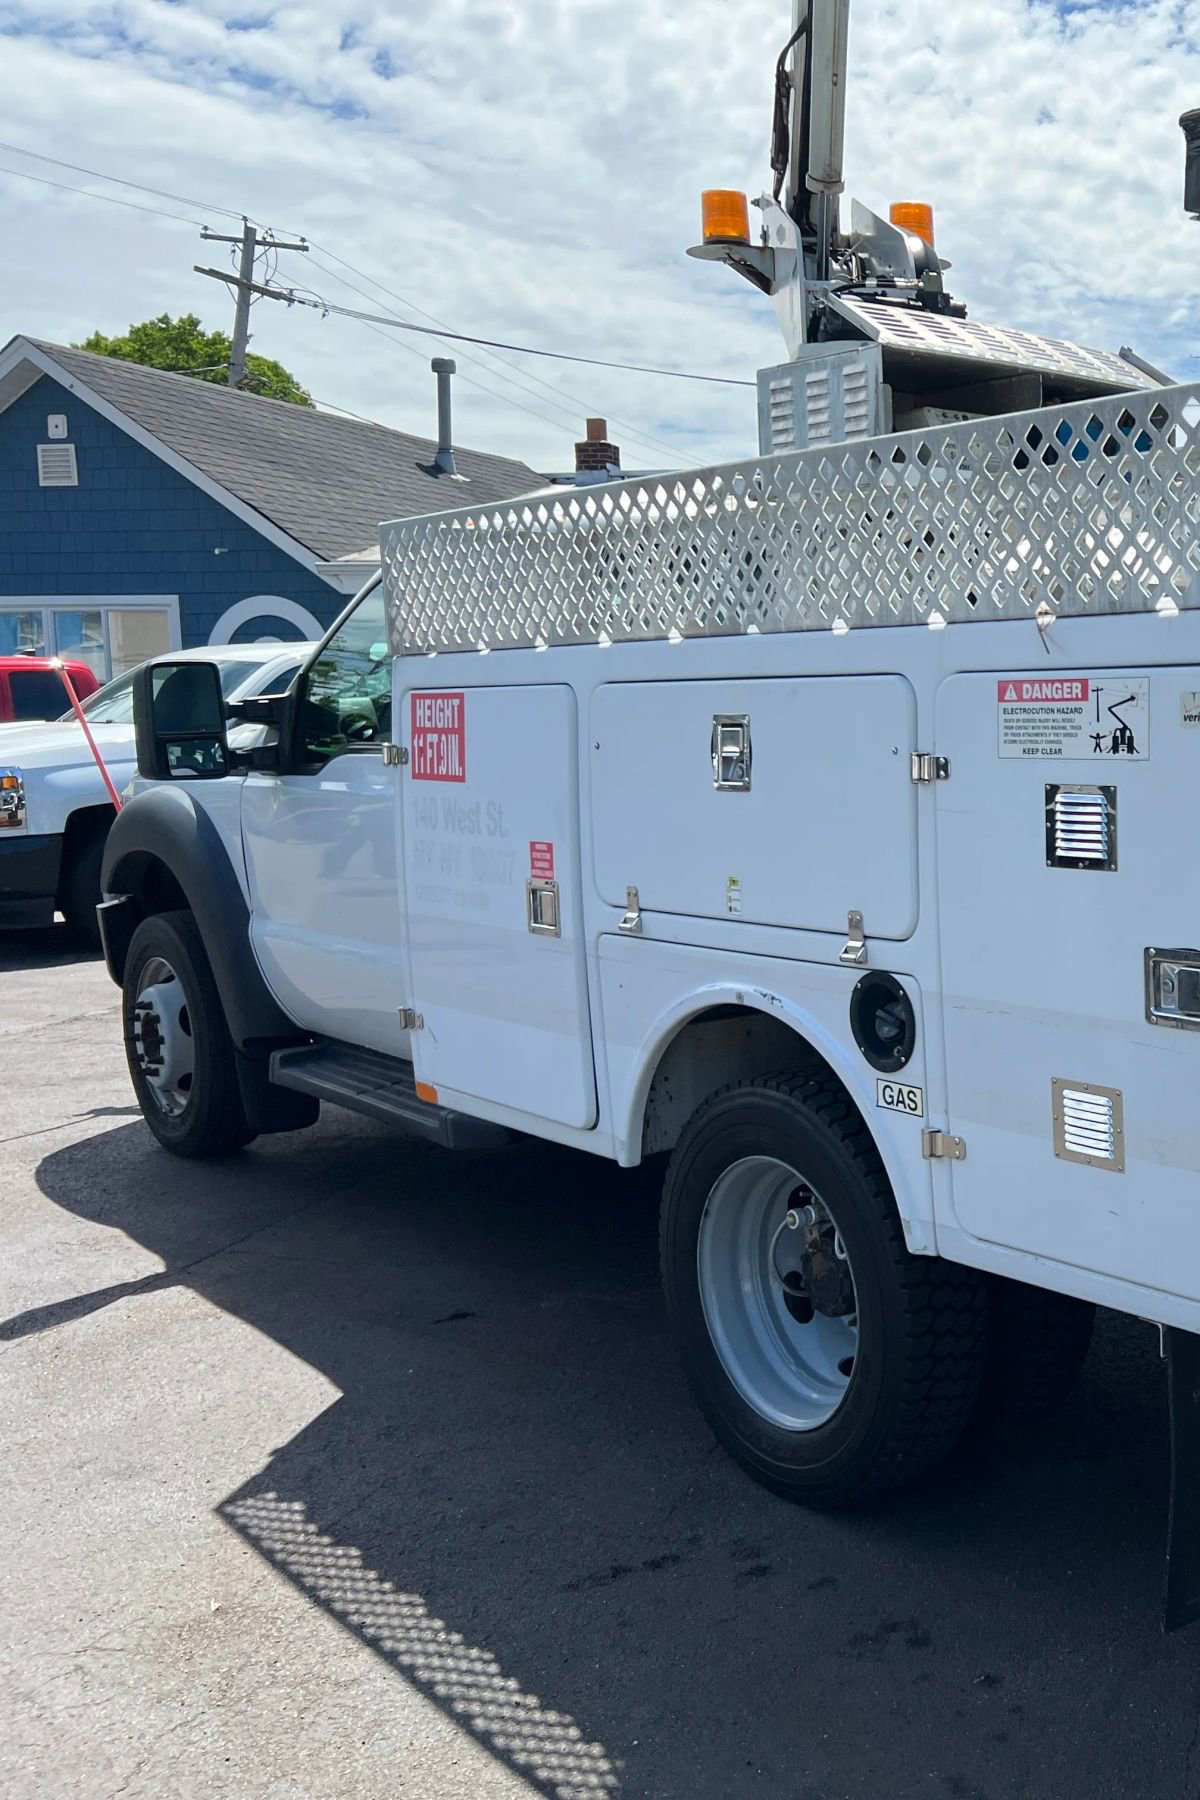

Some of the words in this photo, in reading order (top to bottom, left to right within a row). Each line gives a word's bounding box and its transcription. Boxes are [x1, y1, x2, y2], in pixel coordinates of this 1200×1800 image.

[1022, 682, 1082, 700] DANGER
[416, 698, 460, 729] HEIGHT
[1003, 707, 1055, 715] ELECTROCUTION
[1056, 707, 1084, 715] HAZARD
[441, 796, 483, 835] West
[486, 800, 510, 838] St.
[882, 1084, 918, 1112] GAS
